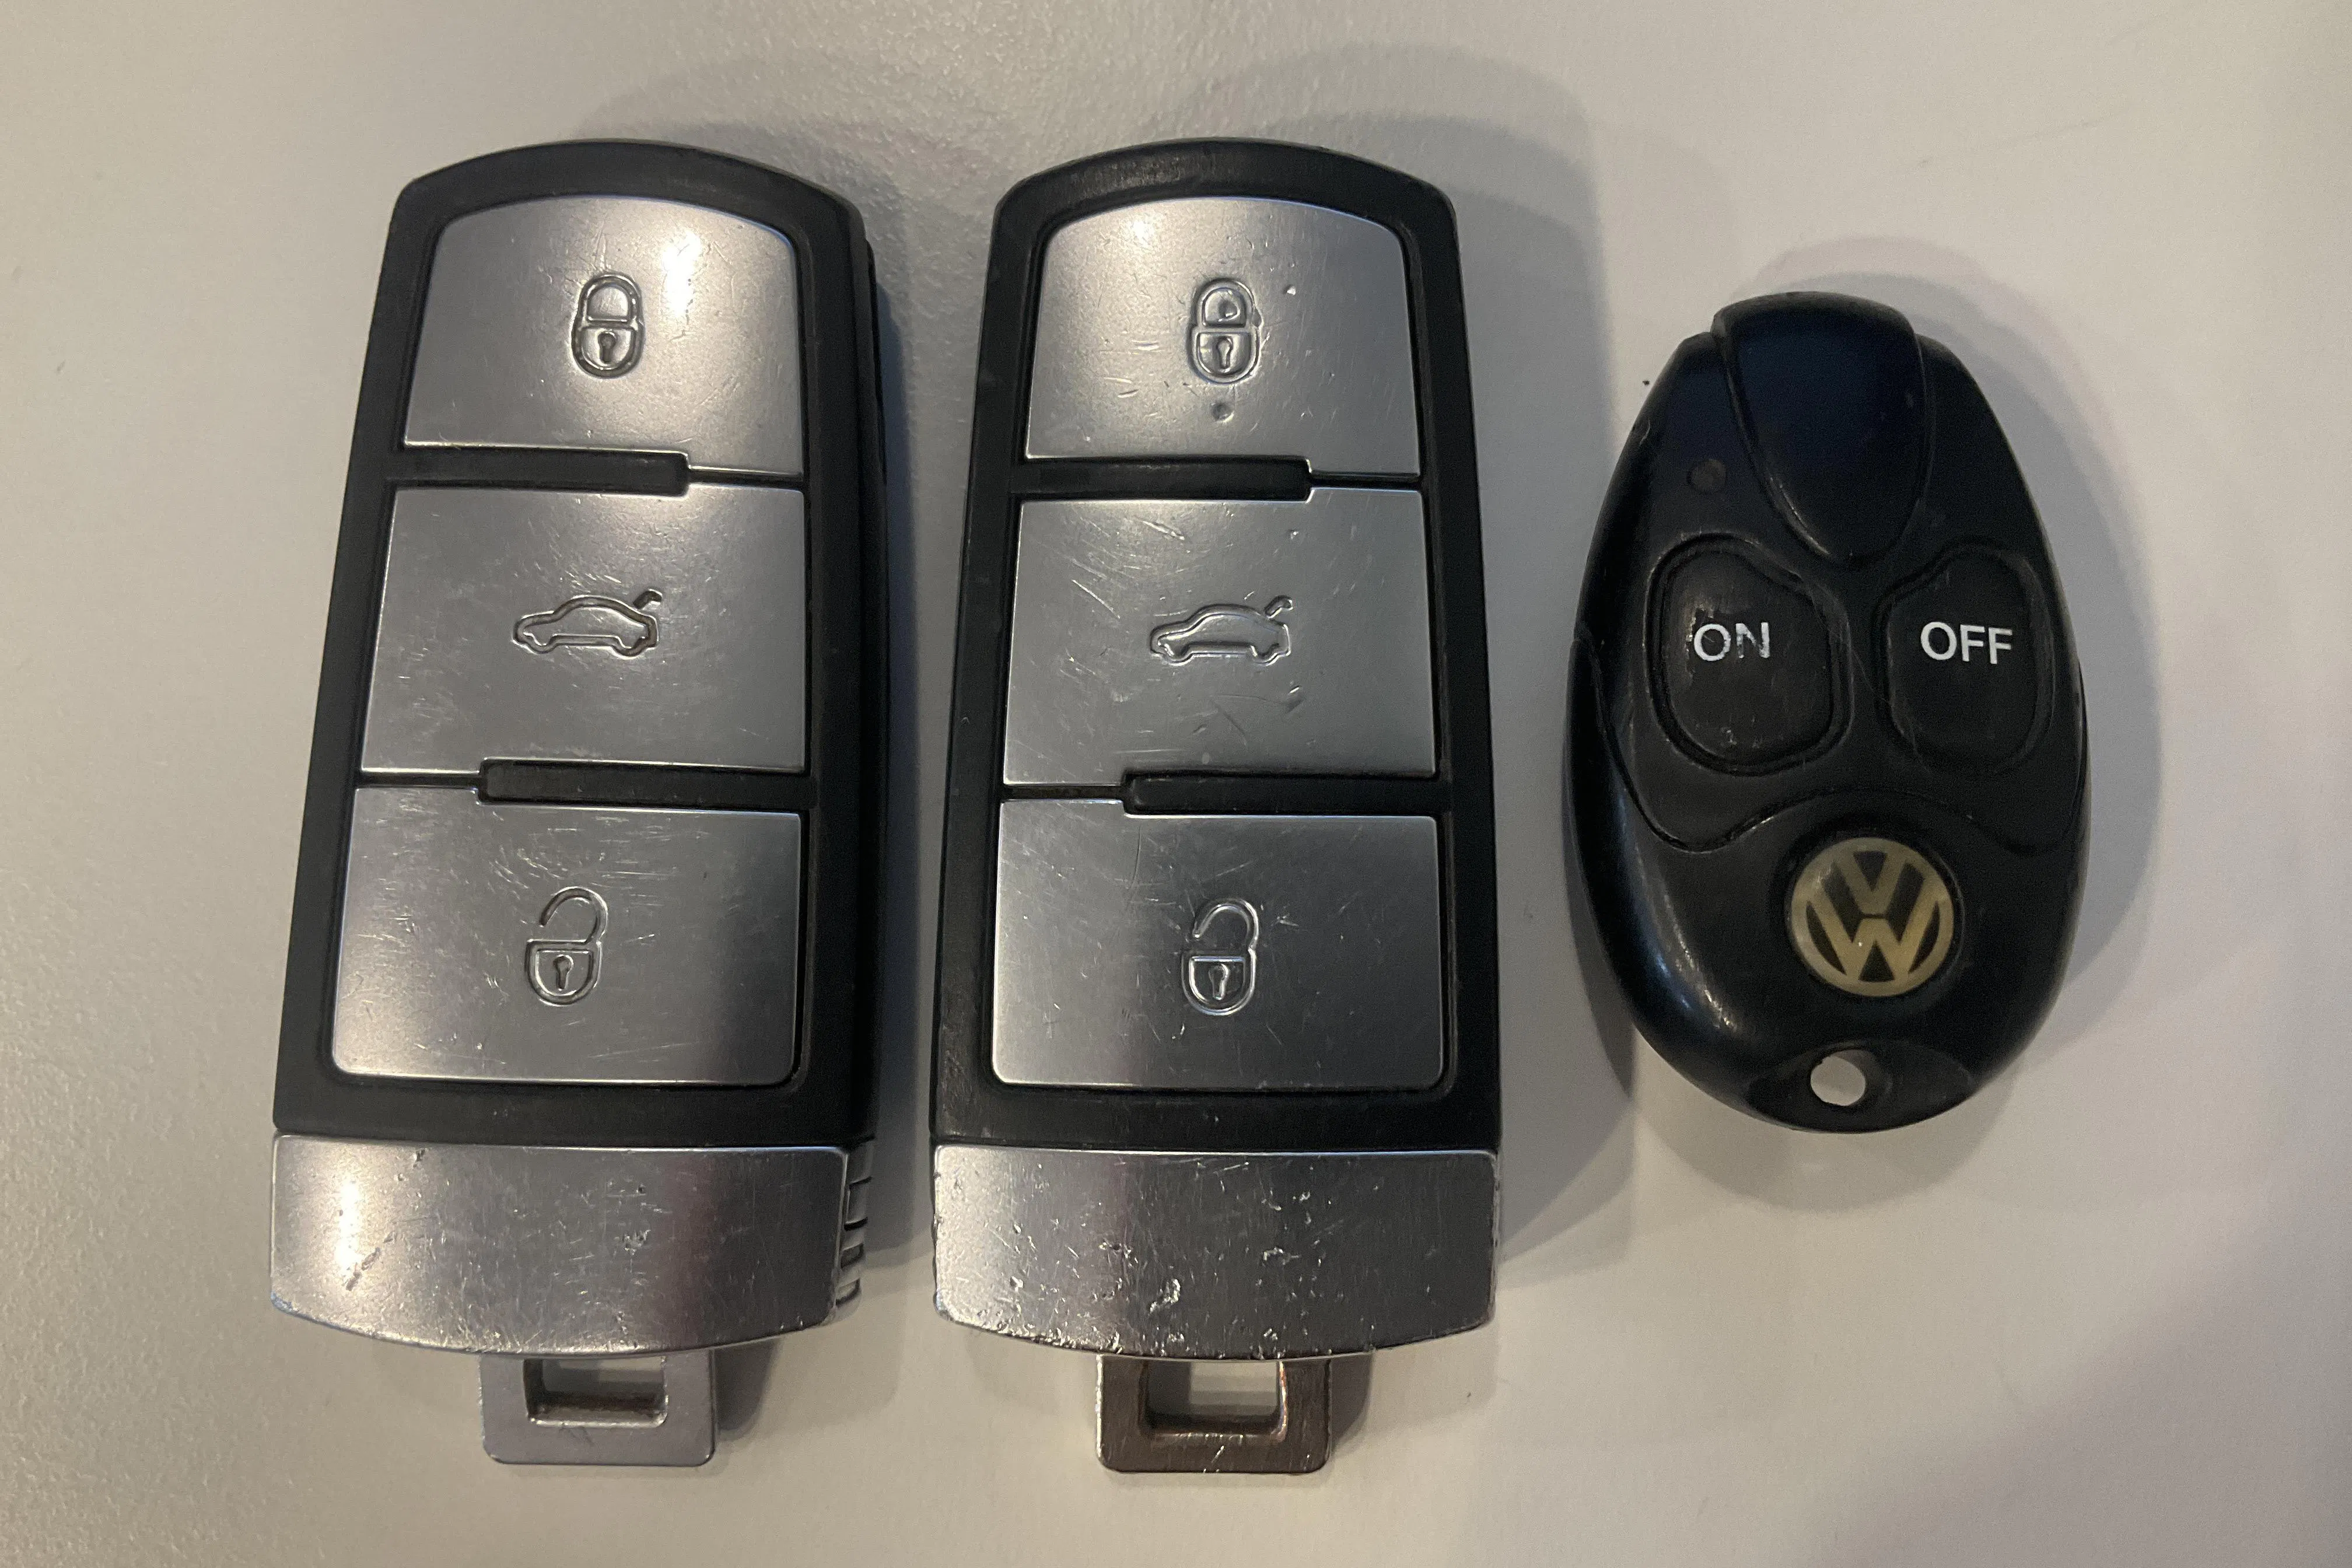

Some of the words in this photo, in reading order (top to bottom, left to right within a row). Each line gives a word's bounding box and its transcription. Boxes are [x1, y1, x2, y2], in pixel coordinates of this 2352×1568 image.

[1693, 621, 1770, 661] ON
[1920, 621, 2013, 664] OFF
[1792, 838, 1954, 996] VW
